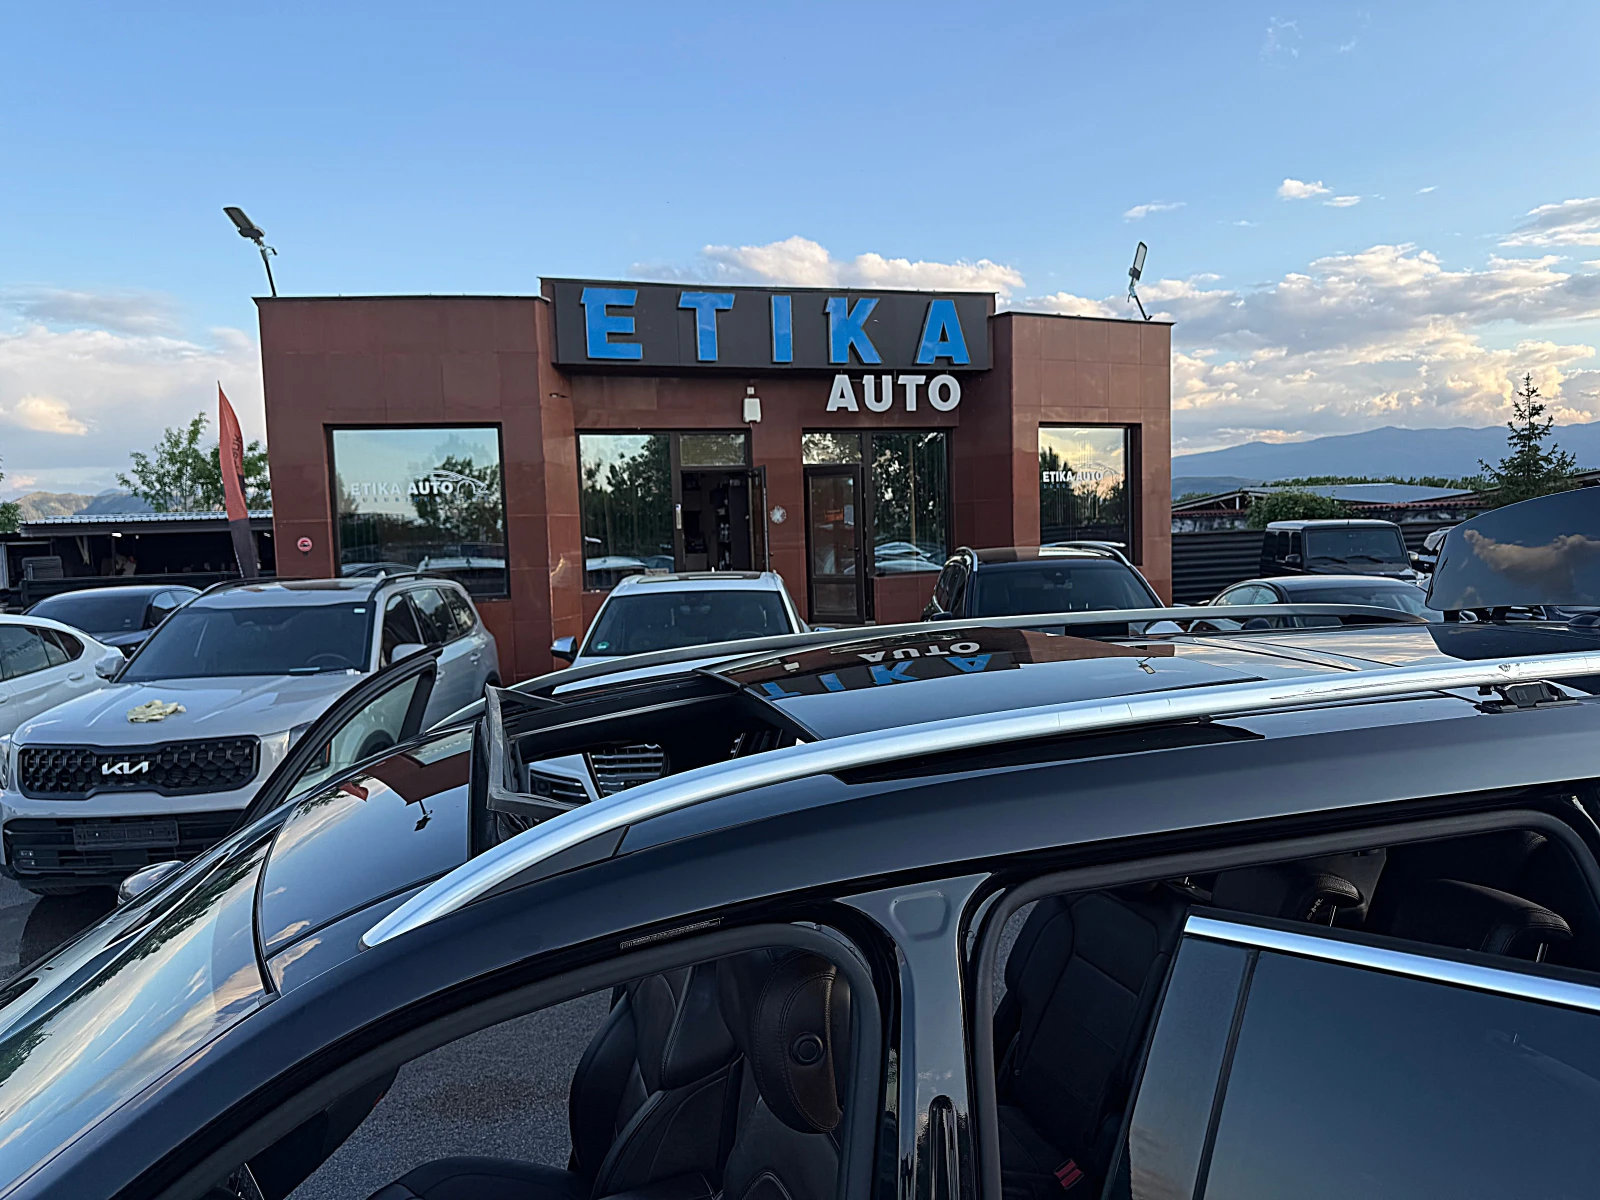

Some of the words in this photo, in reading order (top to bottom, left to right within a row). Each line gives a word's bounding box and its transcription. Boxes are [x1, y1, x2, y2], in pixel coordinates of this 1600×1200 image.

[580, 287, 971, 365] ETIKA
[826, 374, 962, 413] AUTO
[1042, 471, 1073, 483] ETIKA
[1076, 470, 1102, 481] AUTO
[350, 482, 401, 496] ETIKA
[407, 481, 454, 495] AUTO
[101, 760, 151, 775] KIA
